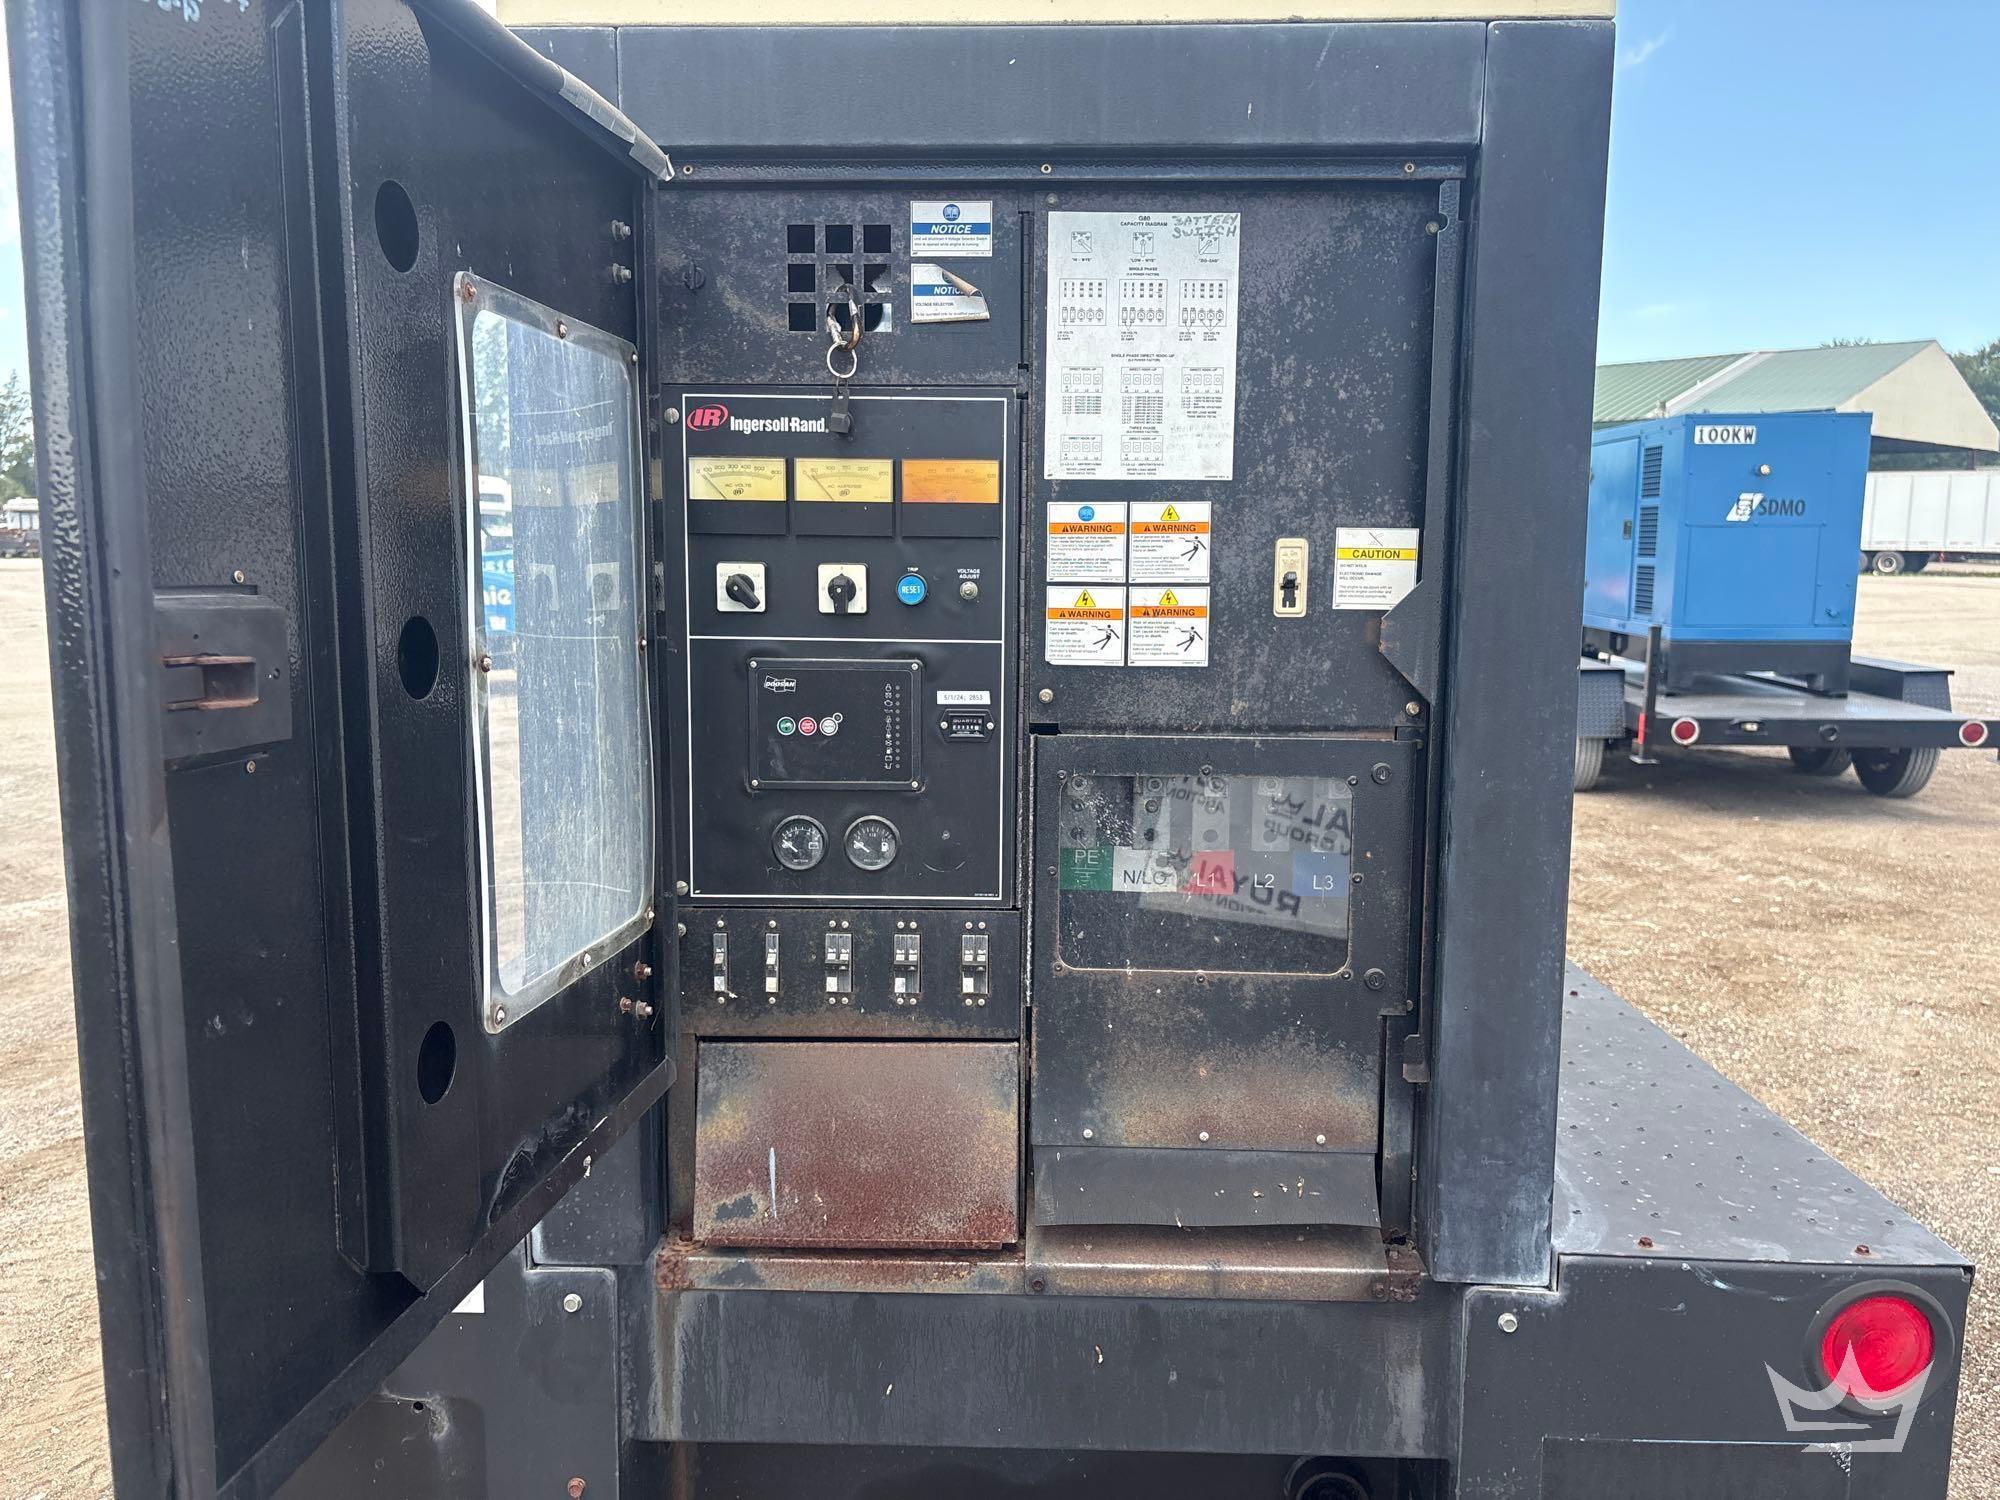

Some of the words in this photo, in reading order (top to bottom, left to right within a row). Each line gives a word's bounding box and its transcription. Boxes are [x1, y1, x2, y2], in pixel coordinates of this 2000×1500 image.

[930, 224, 972, 234] NOTICE
[1171, 226, 1237, 238] SWITCH
[933, 286, 964, 295] NOTIC
[1698, 427, 1754, 443] 100KW
[1757, 500, 1806, 516] SDMO
[1069, 525, 1112, 533] WARNING
[1352, 550, 1400, 559] CAUTION
[901, 585, 921, 594] RESET
[1152, 608, 1195, 616] WARNING
[765, 680, 796, 688] DOOSAN
[1074, 850, 1099, 865] PE
[1196, 874, 1216, 887] L1
[1254, 874, 1274, 888] L2
[1312, 875, 1334, 890] L3
